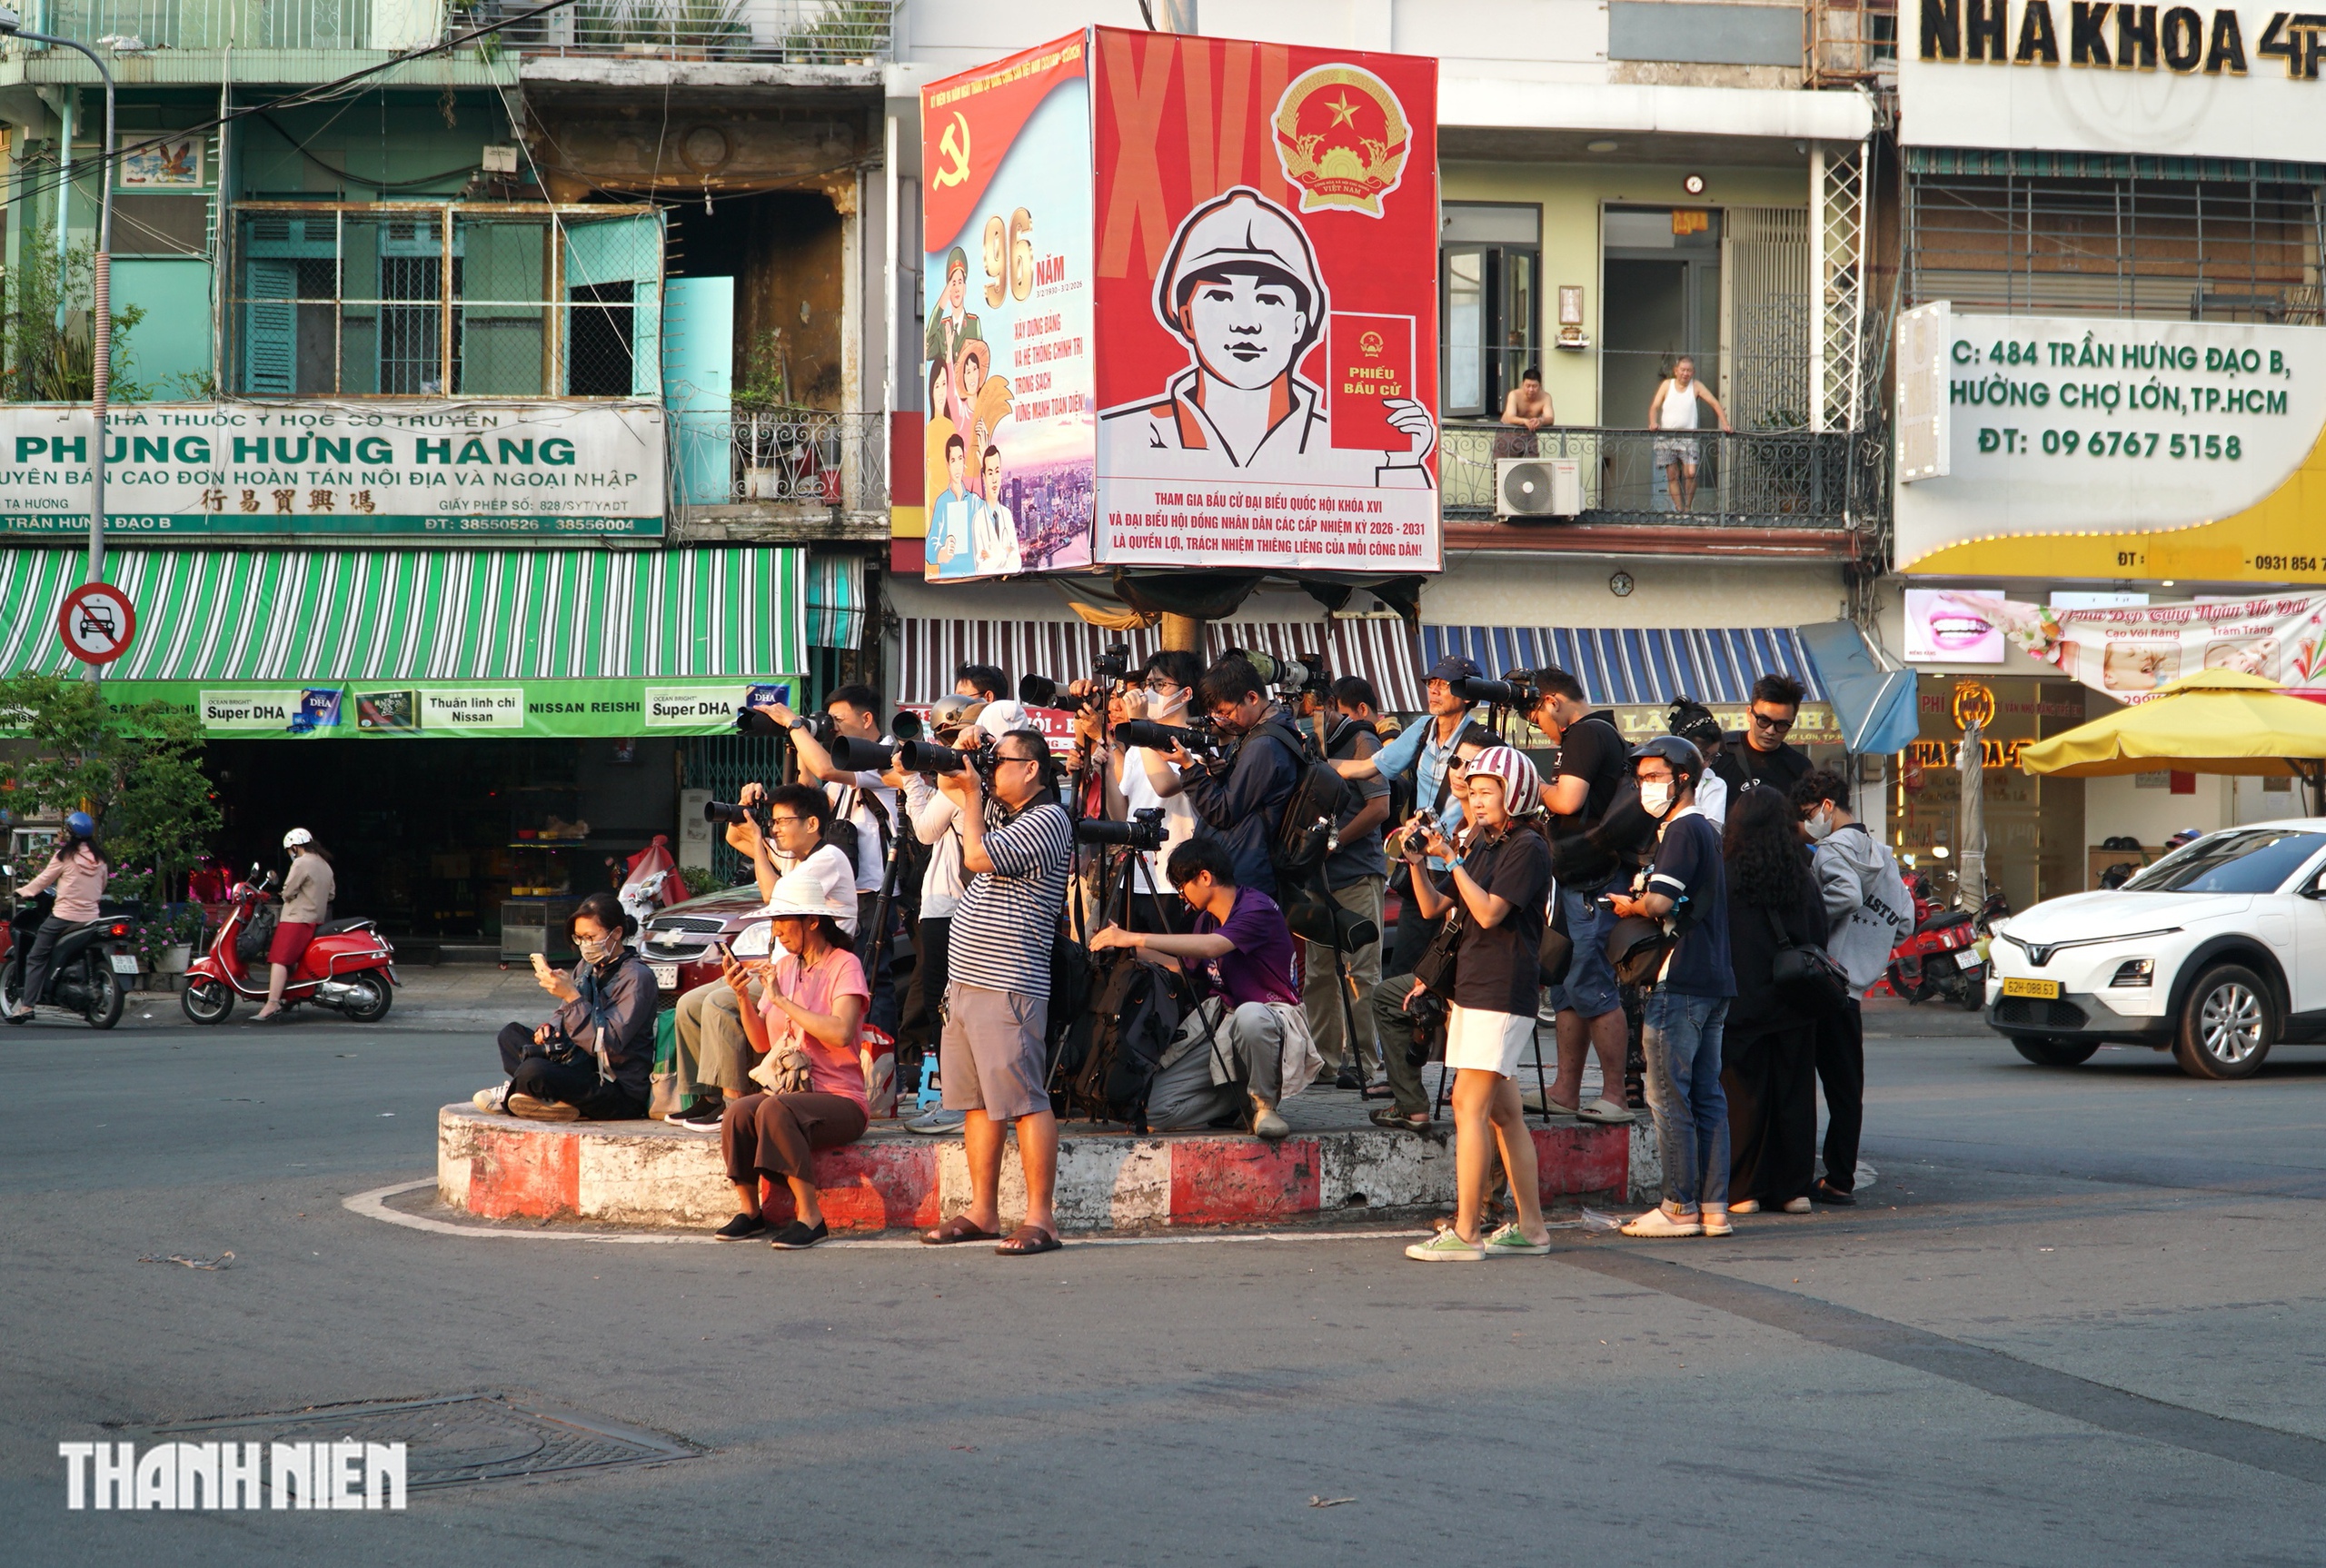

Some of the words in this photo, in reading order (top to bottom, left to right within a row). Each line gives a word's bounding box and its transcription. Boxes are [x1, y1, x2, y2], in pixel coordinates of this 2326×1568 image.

[1919, 0, 2060, 66] NHA
[2069, 1, 2248, 75] KHOA
[1323, 184, 1341, 193] VIỆT
[1344, 185, 1361, 194] NAM
[983, 206, 1033, 309] 96
[1036, 253, 1065, 287] NĂM
[1036, 287, 1058, 298] 3/2/1930
[1061, 281, 1083, 293] 3/2/2026
[1952, 339, 1981, 364] C:
[1989, 340, 2039, 365] 484
[2047, 329, 2115, 369] TRẦN
[2122, 340, 2198, 372] HƯNG
[2204, 345, 2261, 378] ĐẠO
[1348, 365, 1395, 380] PHIẾU
[1014, 374, 1034, 395] TRONG
[1344, 382, 1376, 396] BẦU
[1379, 381, 1402, 396] CỬ
[1949, 372, 2051, 407] HƯỜNG
[2059, 381, 2121, 415] CHỢ
[103, 411, 148, 427] NHÀ
[158, 410, 246, 427] THUỐC
[280, 413, 335, 429] HỌC
[15, 429, 211, 464] PHÙNG
[233, 431, 393, 465] HƯNG
[1978, 427, 2028, 454] ĐT:
[2042, 429, 2081, 456] 09
[2087, 431, 2161, 458] 6767
[2169, 432, 2242, 460] 5158
[0, 467, 58, 485] UYÊN
[121, 471, 171, 486] CAO
[176, 469, 225, 486] ĐƠN
[234, 468, 299, 486] HOÀN
[306, 468, 353, 487] TÁN
[362, 468, 401, 490] NỘI
[409, 471, 447, 490] ĐỊA
[456, 468, 485, 487] VÀ
[492, 471, 567, 490] NGOẠI
[573, 469, 638, 490] NHẬP
[5, 498, 20, 511] TẠ
[25, 497, 69, 510] HƯƠNG
[439, 497, 469, 511] GIẤY
[473, 498, 507, 511] PHÉP
[1155, 492, 1184, 506] THAM
[1187, 494, 1203, 507] GIA
[1207, 491, 1227, 508] BẦU
[1229, 491, 1245, 508] CỬ
[1245, 496, 1263, 511] ĐẠI
[1264, 491, 1287, 510] BIỂU
[1290, 492, 1317, 511] QUỐC
[1319, 494, 1336, 512] HỘI
[1338, 496, 1363, 512] KHÓA
[1367, 501, 1383, 514] XVI
[5, 513, 57, 530] TRẦN
[114, 516, 154, 531] ĐẠO
[159, 517, 172, 529] B
[424, 519, 454, 531] ĐT:
[460, 519, 539, 531] 38550526
[555, 519, 635, 531] 38556004
[1108, 511, 1123, 527] VÀ
[1125, 514, 1143, 529] ĐẠI
[1145, 510, 1168, 528] BIỂU
[1170, 512, 1188, 531] HỘI
[1190, 511, 1218, 529] ĐỒNG
[1221, 513, 1249, 531] NHÂN
[1252, 514, 1272, 531] DÂN
[1276, 514, 1296, 532] CÁC
[1297, 514, 1317, 533] CẤP
[1320, 516, 1352, 536] NHIỆM
[1355, 517, 1368, 534] KỲ
[1370, 521, 1394, 535] 2026
[1403, 522, 1425, 536] 2031
[1114, 532, 1127, 549] LÀ
[1128, 531, 1161, 550] QUYỀN
[1163, 535, 1184, 552] LỢI,
[1187, 534, 1219, 551] TRÁCH
[1221, 535, 1254, 554] NHIỆM
[1257, 536, 1292, 553] THIÊNG
[1295, 538, 1323, 554] LIÊNG
[1326, 536, 1346, 555] CỦA
[1348, 537, 1367, 556] MỖI
[1369, 539, 1396, 556] CÔNG
[1398, 540, 1423, 557] DÂN!
[2255, 555, 2288, 571] 0931
[2291, 556, 2317, 571] 854
[2105, 629, 2127, 640] Cạo
[2130, 628, 2148, 638] Vôi
[2151, 628, 2181, 640] Răng
[2211, 625, 2241, 636] Trám
[310, 698, 332, 708] DHA
[471, 697, 495, 709] linh
[498, 697, 516, 709] chi
[754, 693, 776, 702] DHA
[1921, 693, 1945, 713] PHÍ
[207, 706, 250, 721] Super
[253, 706, 285, 719] DHA
[529, 702, 585, 713] NISSAN
[591, 701, 641, 713] REISHI
[652, 701, 695, 718] Super
[699, 701, 731, 715] DHA
[452, 711, 493, 722] Nissan
[1622, 709, 1675, 733] LÂ
[2007, 980, 2054, 996] 62H-088.63
